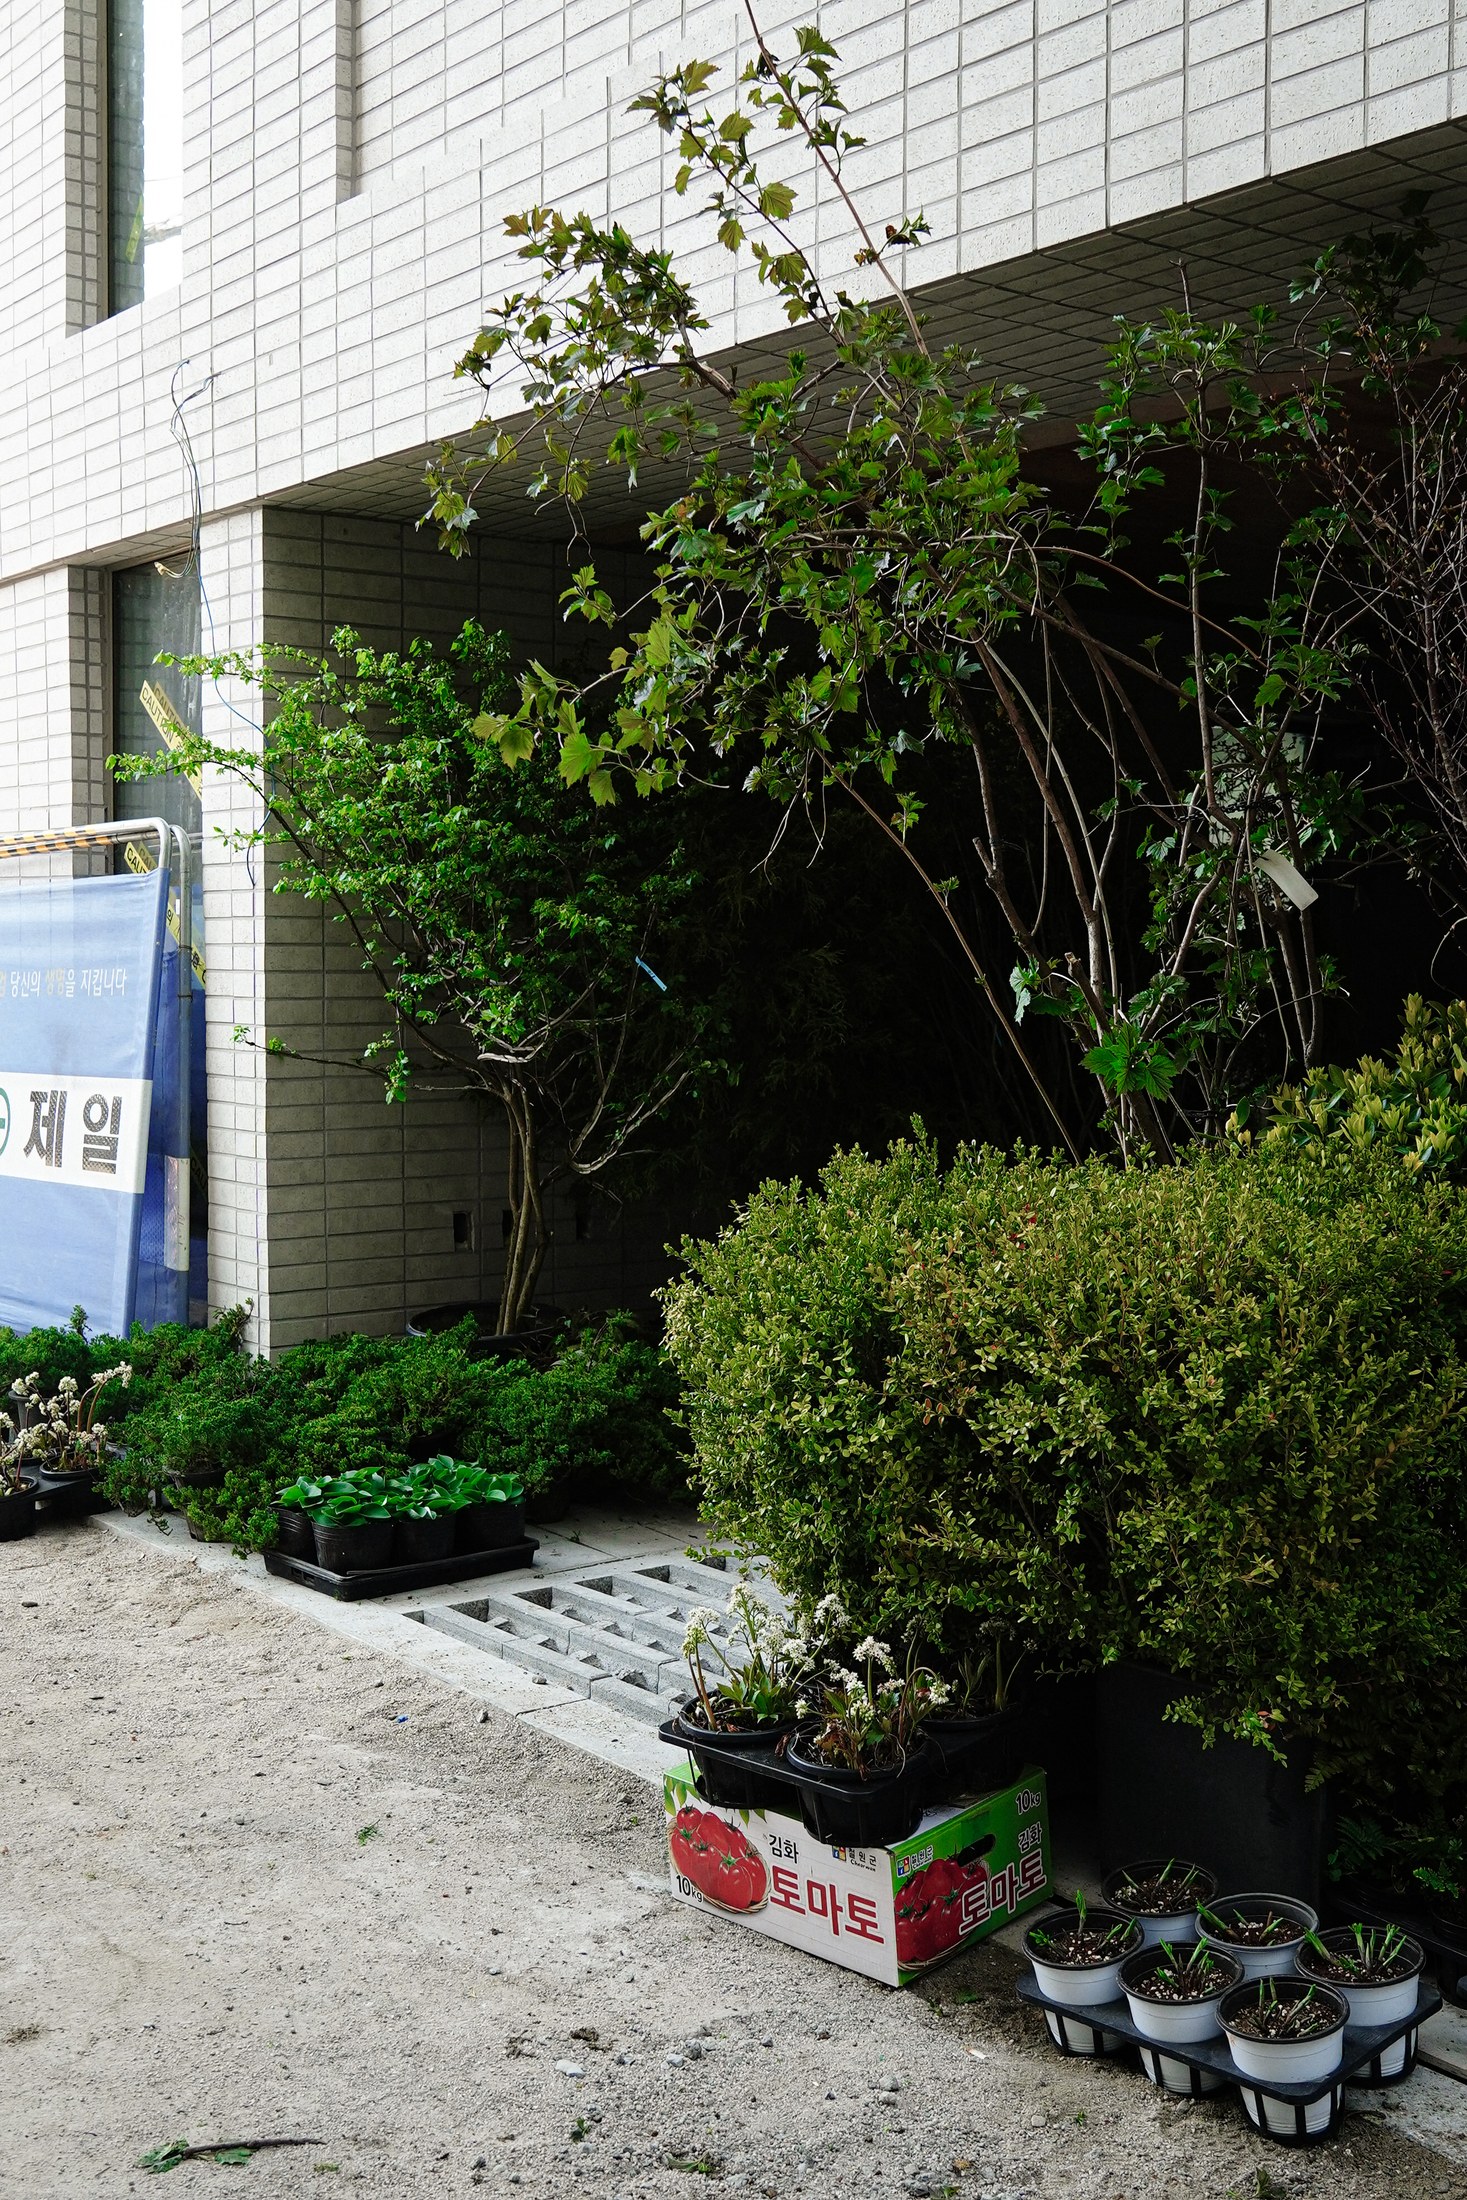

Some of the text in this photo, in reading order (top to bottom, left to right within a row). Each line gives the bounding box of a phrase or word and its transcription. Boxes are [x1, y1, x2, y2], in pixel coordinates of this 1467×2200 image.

[10, 970, 41, 998] 당신의
[80, 967, 127, 997] 지킵니다
[1015, 1789, 1041, 1815] 10kg
[769, 1834, 799, 1864] 김화
[1018, 1821, 1042, 1853] 김화
[676, 1875, 703, 1903] 10kg
[958, 1848, 1047, 1935] 토마토
[770, 1865, 885, 1945] 토마토
